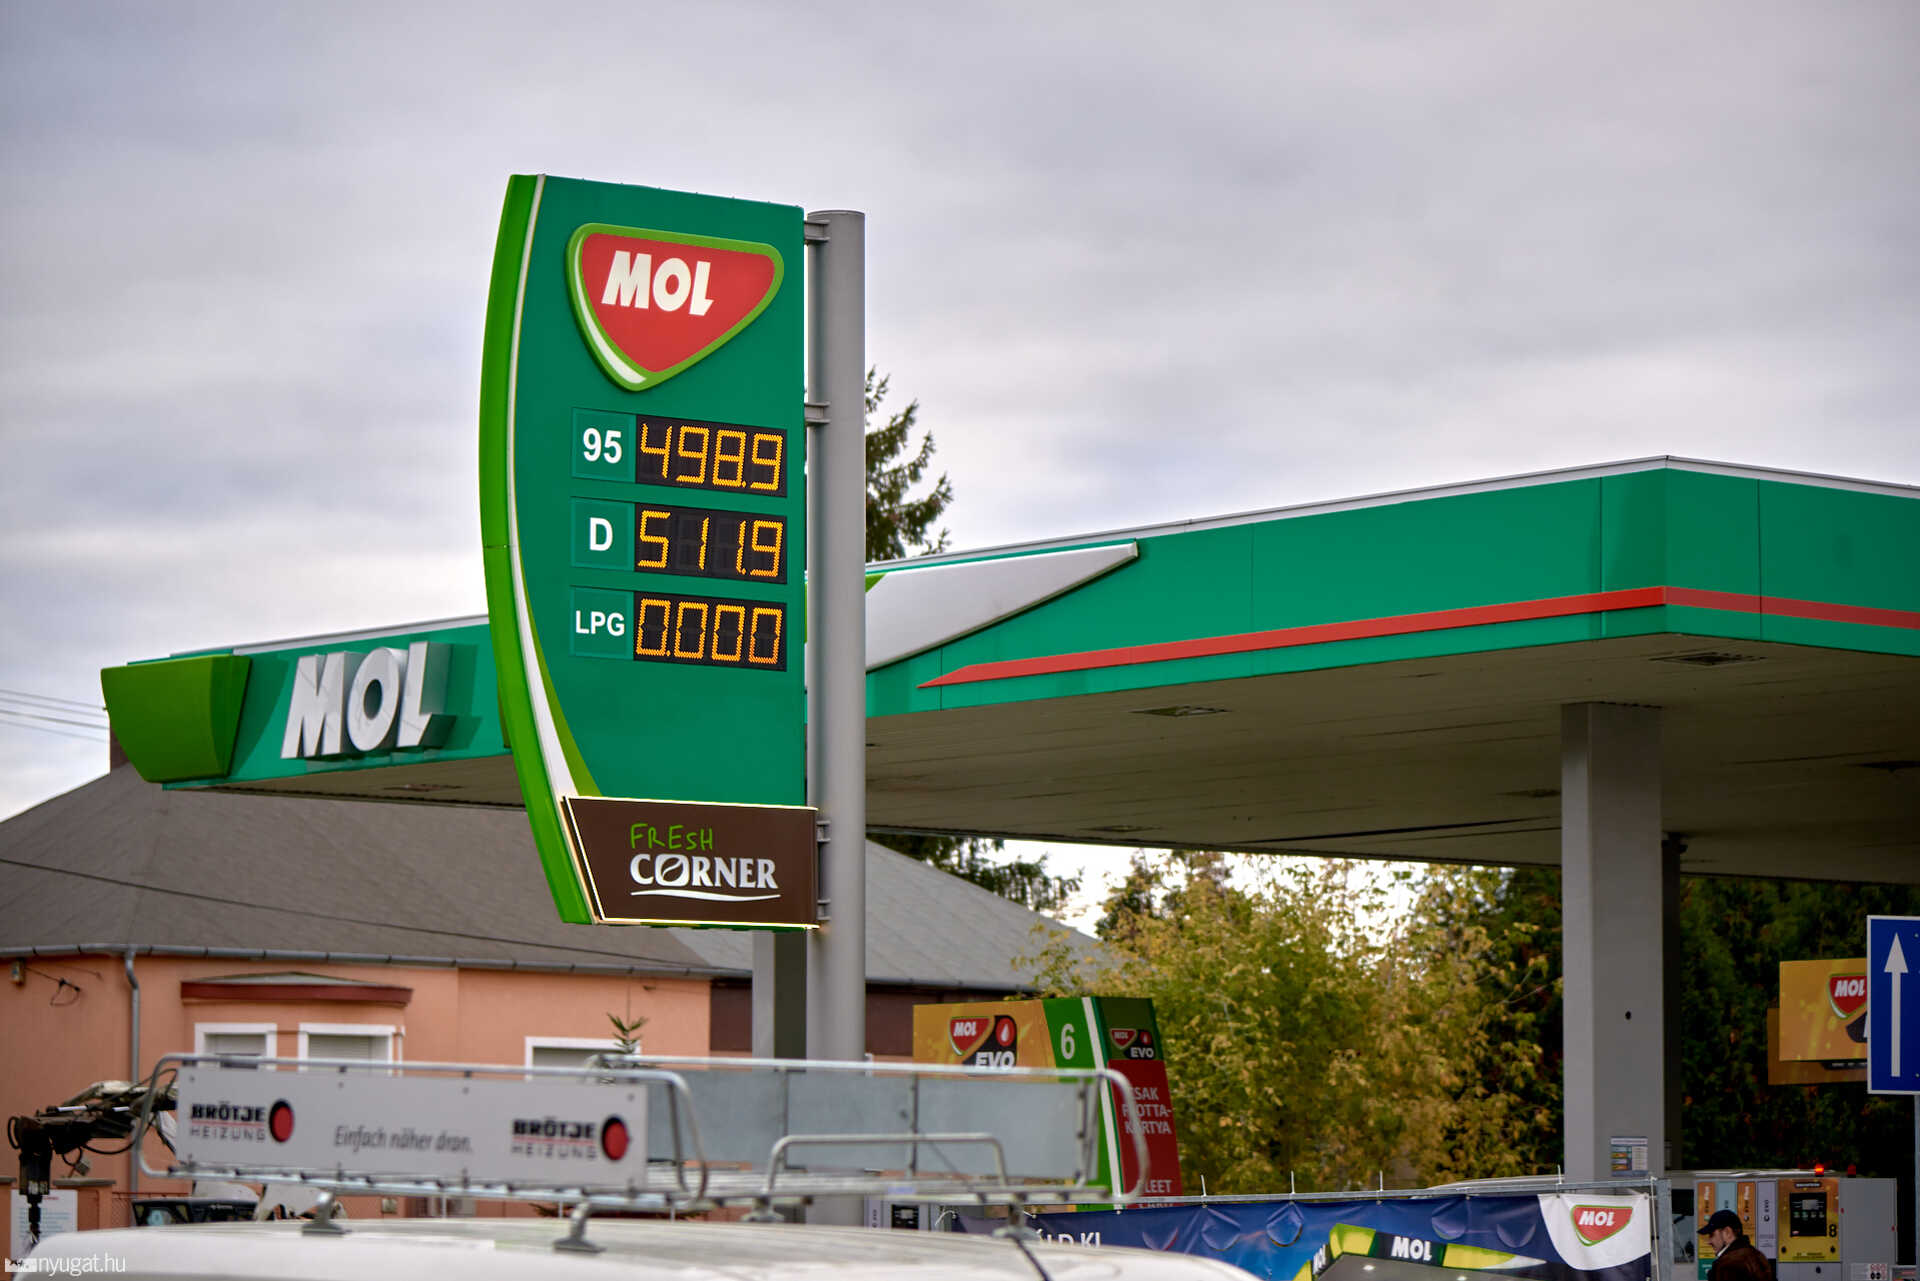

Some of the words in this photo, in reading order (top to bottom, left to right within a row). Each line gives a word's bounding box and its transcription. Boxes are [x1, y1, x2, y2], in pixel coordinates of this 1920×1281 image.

[601, 249, 714, 316] MOL
[582, 426, 623, 464] 95
[640, 422, 784, 491] 498.9
[588, 516, 614, 552] D
[637, 509, 784, 577] 511.9
[574, 610, 626, 637] LPG
[280, 640, 434, 759] MOL
[629, 822, 713, 850] FRESH
[629, 852, 779, 889] CORNER
[1834, 979, 1866, 997] MOL
[952, 1020, 978, 1037] MOL
[1060, 1022, 1076, 1060] 6
[974, 1050, 1016, 1068] EVO
[1130, 1046, 1154, 1058] EVO
[1130, 1086, 1160, 1101] SAK
[190, 1101, 266, 1122] BRÖTJE
[1122, 1103, 1172, 1118] FOTTA-
[190, 1126, 266, 1142] HEIZUNG
[512, 1116, 597, 1138] BRÖTJE
[1124, 1120, 1173, 1135] KRTYA
[334, 1124, 387, 1153] Einfach
[1142, 1179, 1173, 1194] LEET
[1578, 1210, 1616, 1227] MOL
[1828, 1223, 1838, 1238] 8
[1390, 1235, 1433, 1262] MOL
